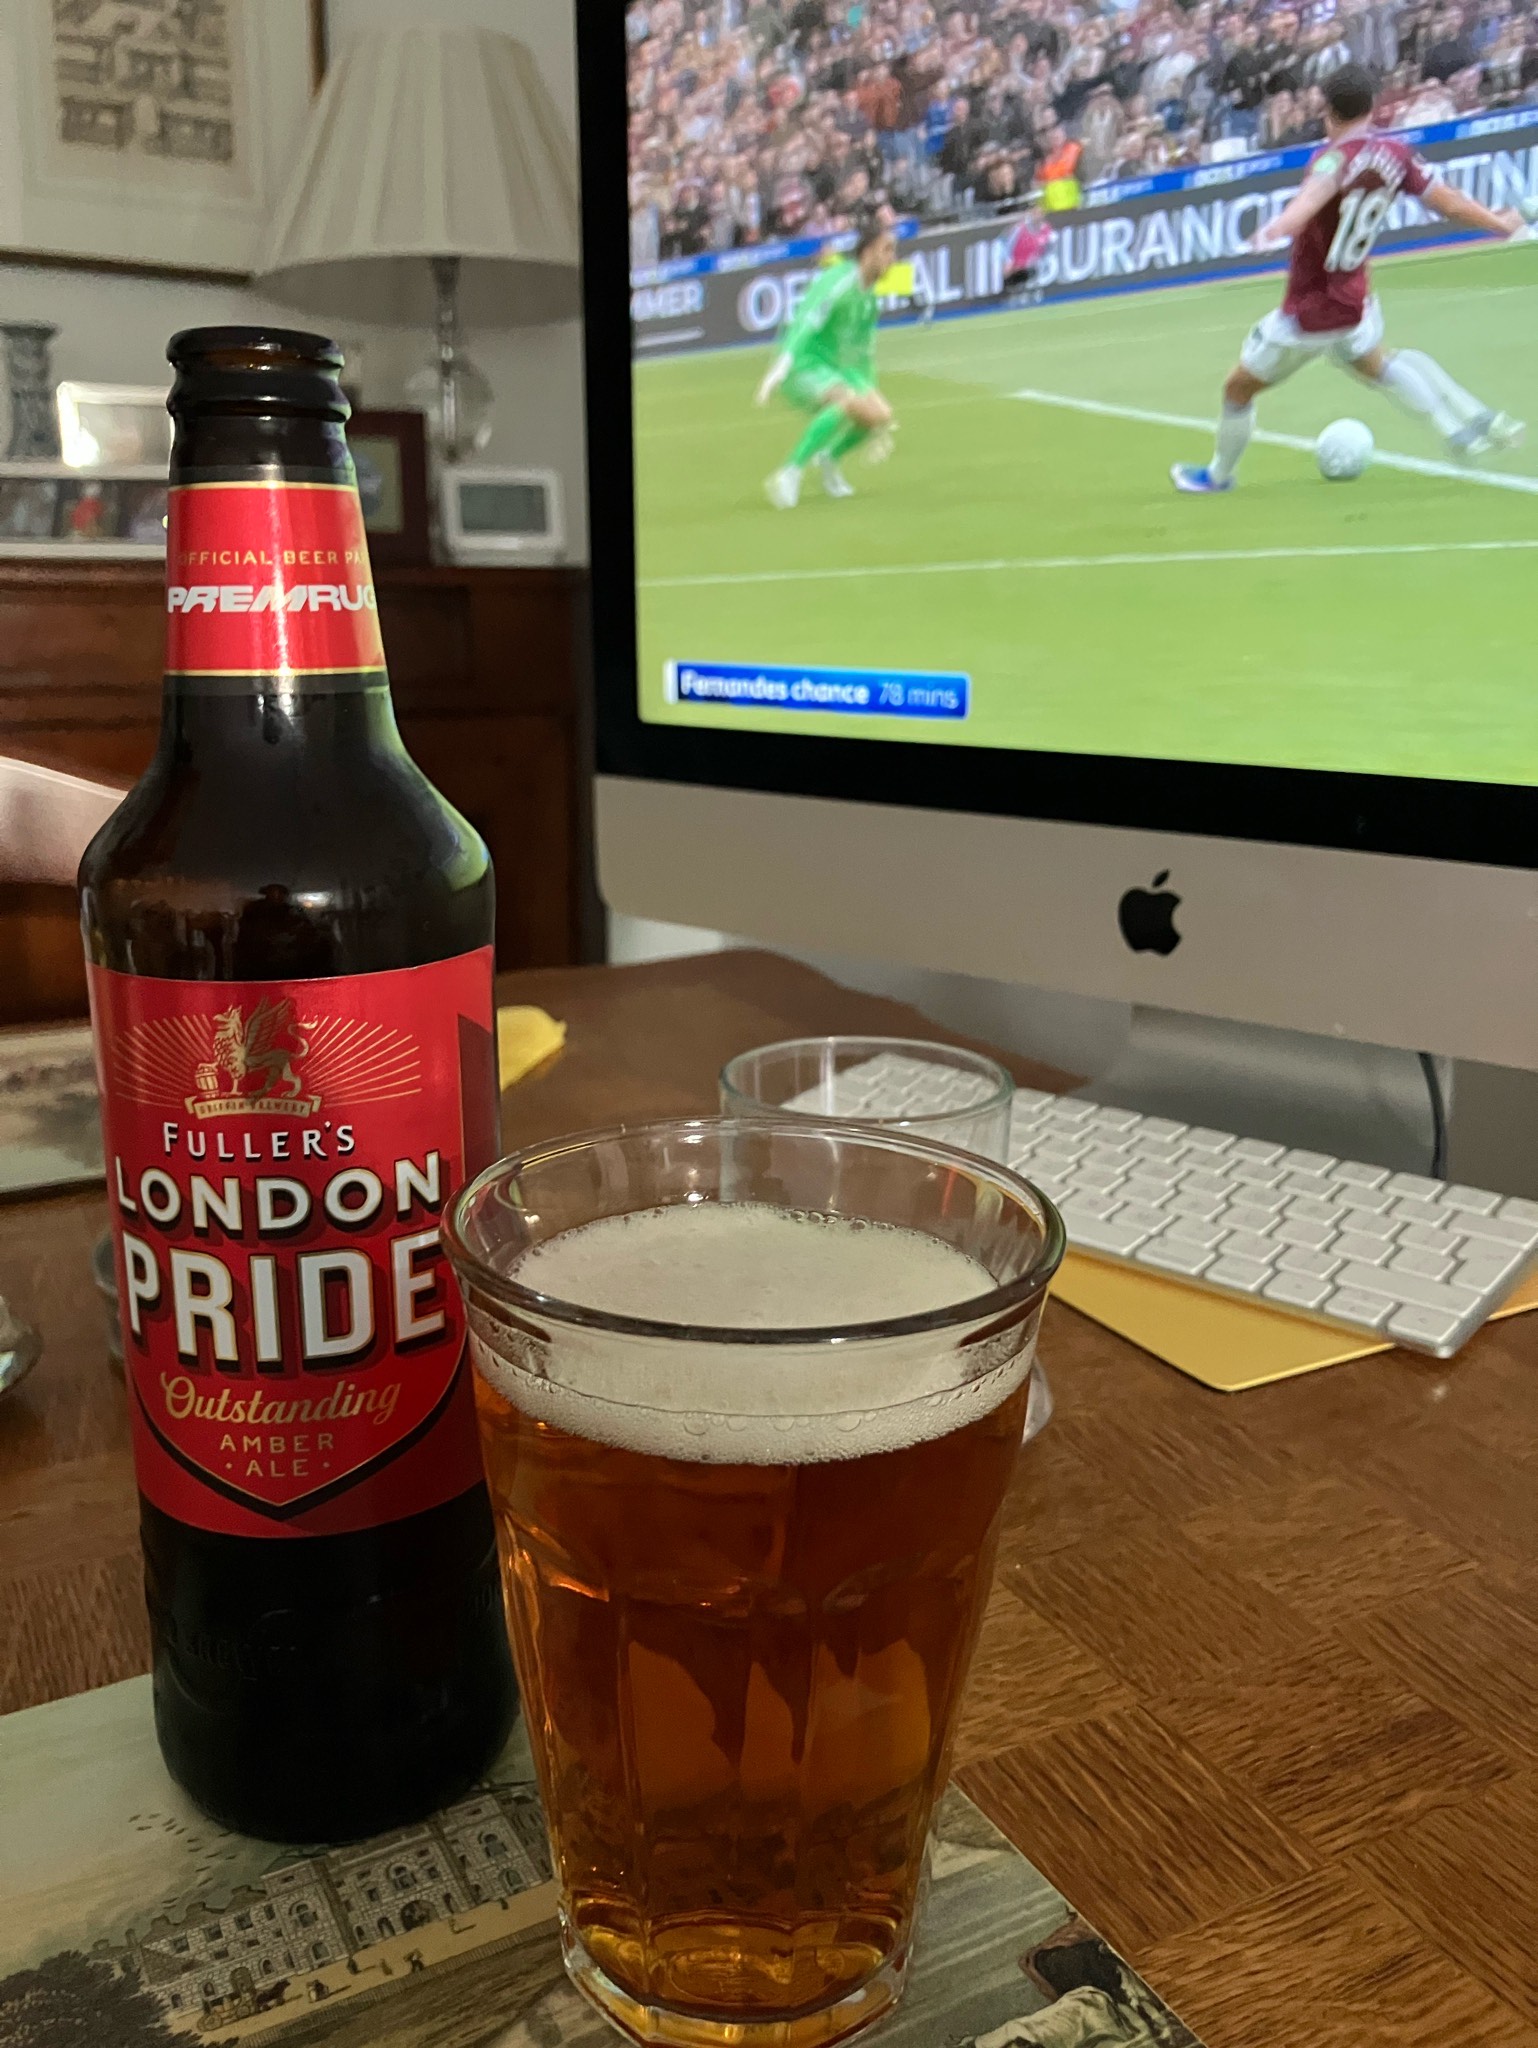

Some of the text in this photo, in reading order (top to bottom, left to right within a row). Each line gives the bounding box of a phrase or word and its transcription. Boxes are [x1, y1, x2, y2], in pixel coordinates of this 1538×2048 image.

[1324, 187, 1389, 272] 18
[283, 550, 339, 565] BEER
[680, 668, 959, 709] Fernandes chance 78 mins
[163, 1121, 356, 1159] FULLER'S
[115, 1150, 443, 1233] LONDON
[122, 1228, 447, 1366] PRIDE
[160, 1371, 401, 1425] Outstanding
[220, 1433, 334, 1454] AMBER
[245, 1458, 309, 1477] ALE
